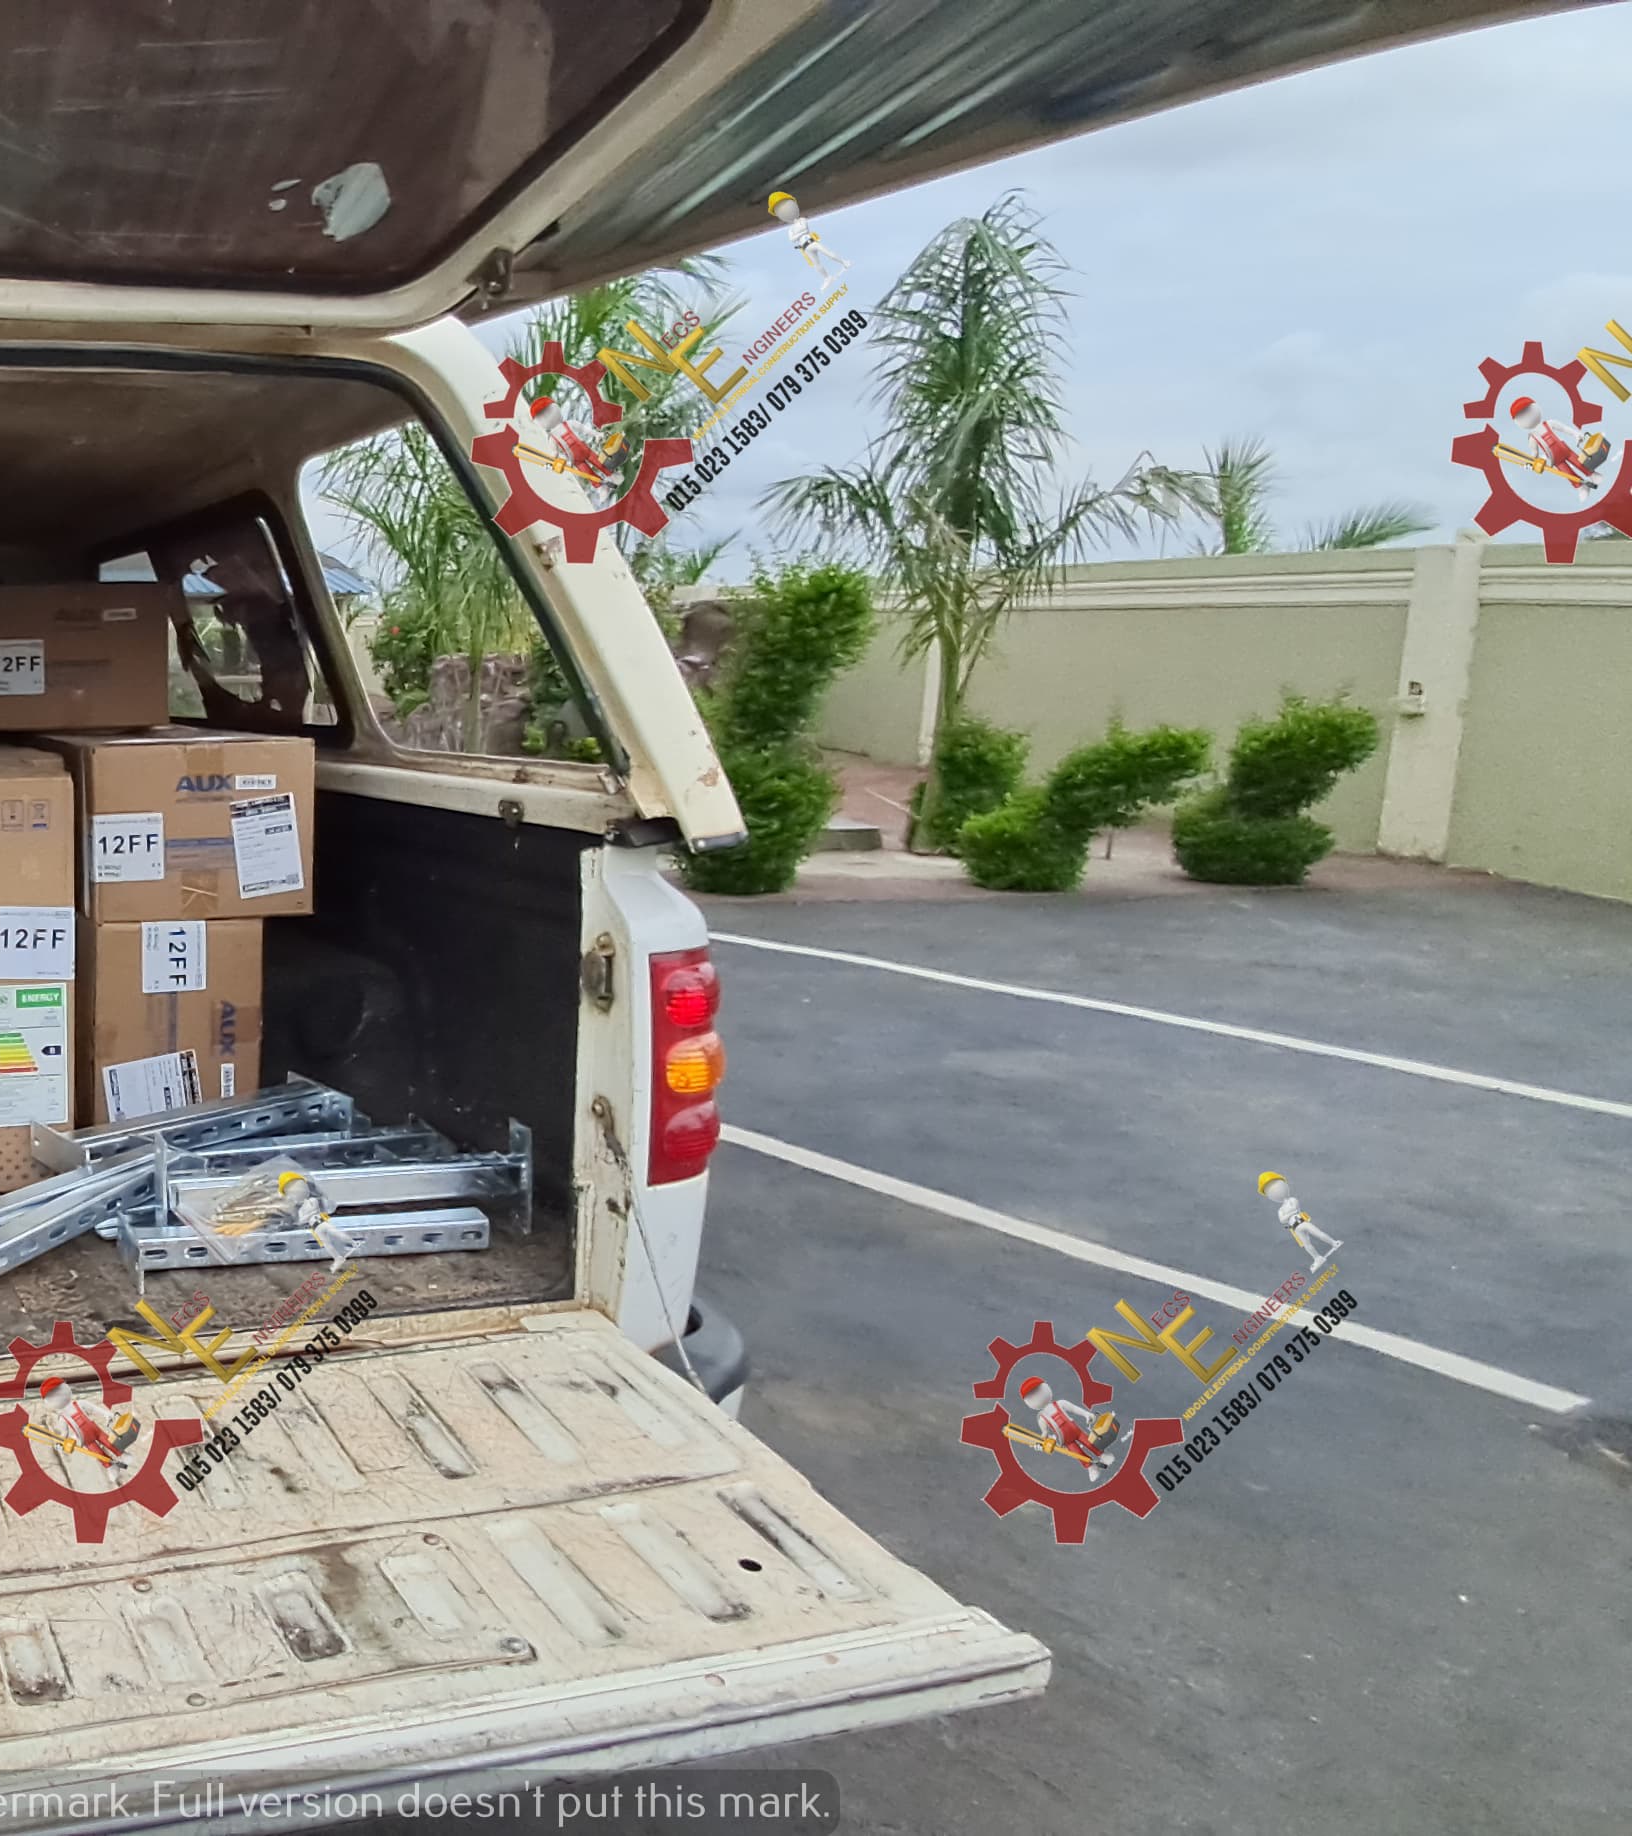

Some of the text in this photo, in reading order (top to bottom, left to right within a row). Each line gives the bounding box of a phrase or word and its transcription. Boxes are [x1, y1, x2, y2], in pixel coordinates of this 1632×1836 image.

[176, 775, 233, 793] AUX
[98, 833, 159, 855] 12FF
[0, 928, 67, 950] 12FF
[168, 926, 187, 987] 12FF
[22, 992, 59, 1003] ENERGY
[220, 1001, 237, 1057] AUX
